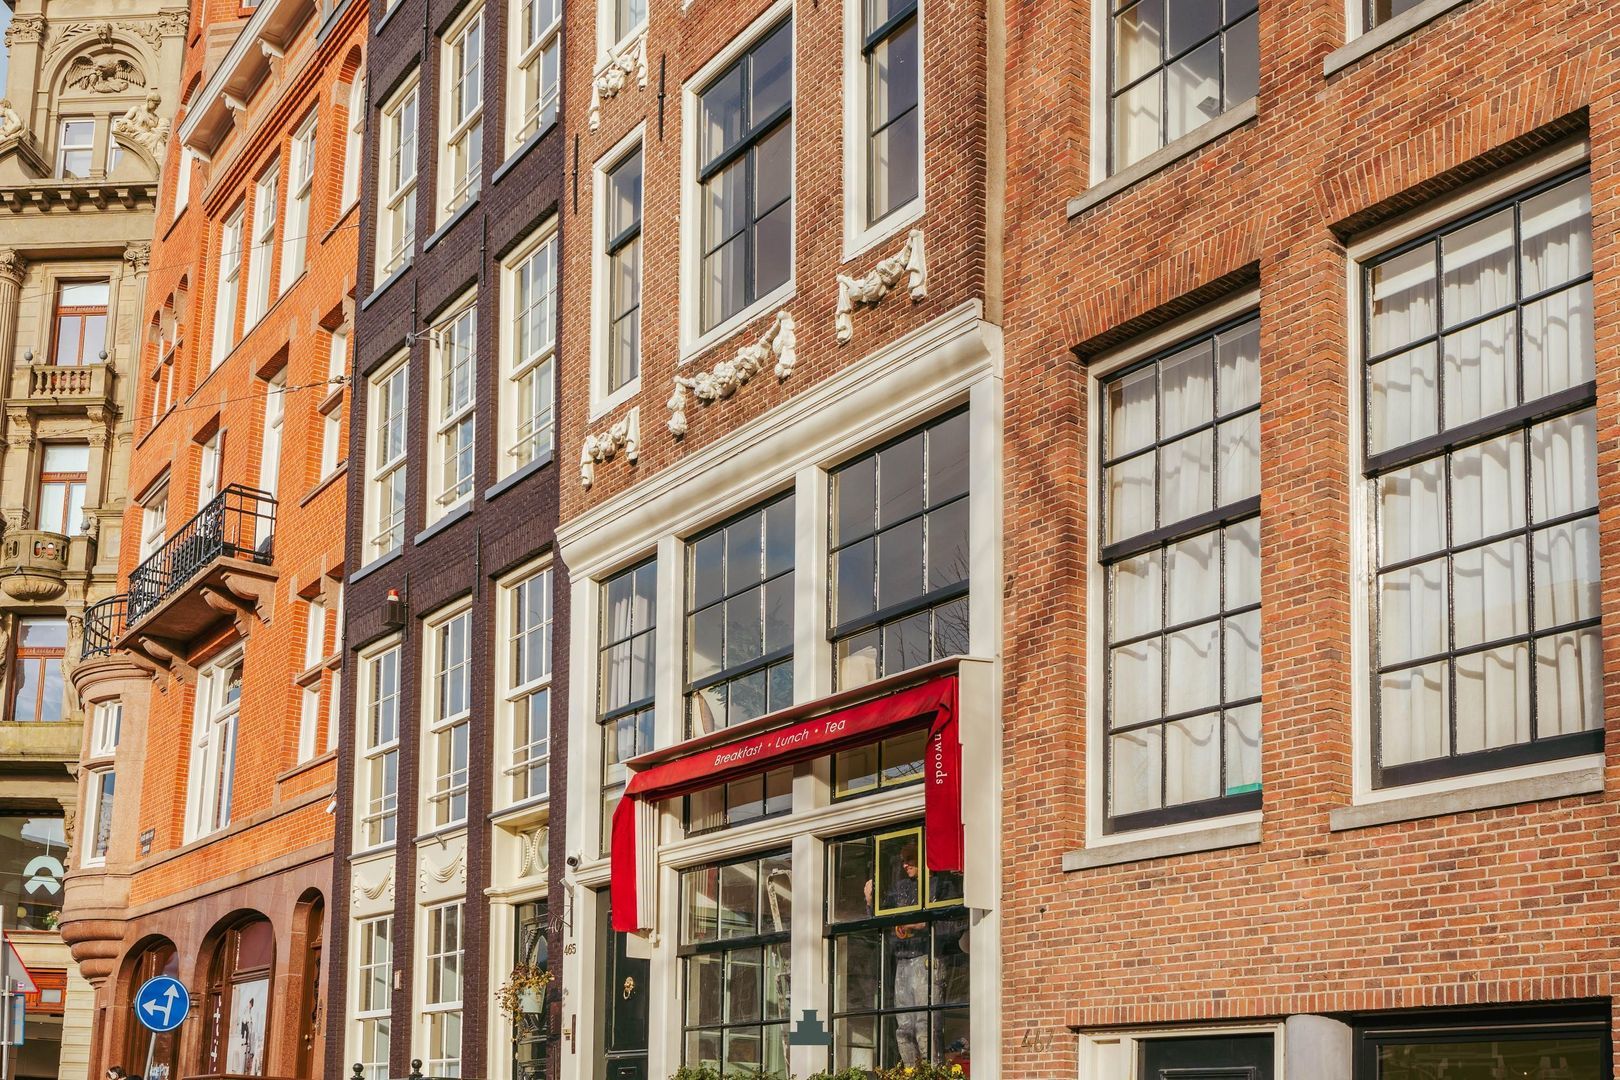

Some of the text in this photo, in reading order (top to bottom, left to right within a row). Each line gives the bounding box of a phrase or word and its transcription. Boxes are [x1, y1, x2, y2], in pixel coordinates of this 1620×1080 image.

[714, 719, 846, 766] Breakfast Lunch Tea
[934, 731, 948, 785] nwoods
[563, 943, 577, 956] 465
[1020, 1028, 1054, 1053] 467
